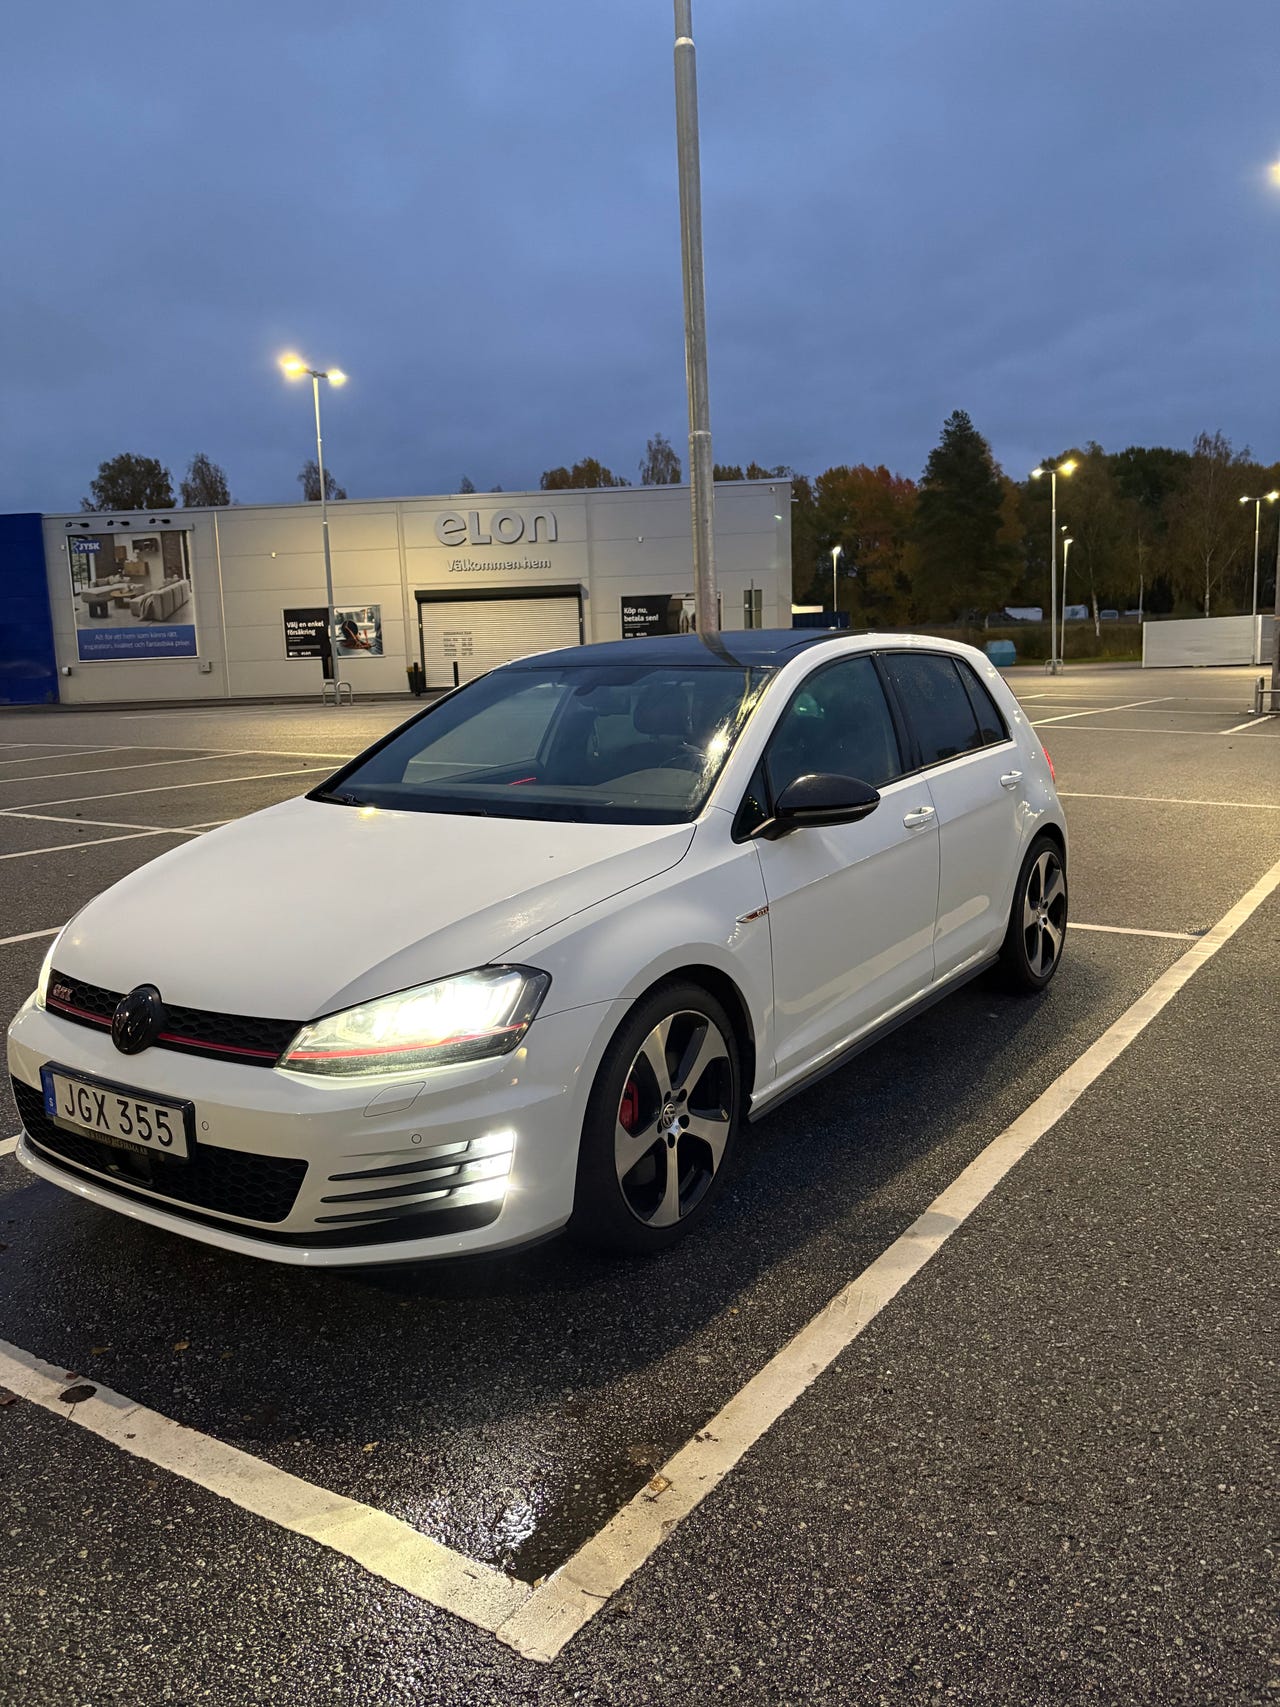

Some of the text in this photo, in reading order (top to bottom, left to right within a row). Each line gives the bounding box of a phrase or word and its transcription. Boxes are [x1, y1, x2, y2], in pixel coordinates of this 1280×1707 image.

[79, 542, 100, 551] JYSK
[447, 557, 551, 572] Välkommen hem
[624, 614, 644, 622] betala
[286, 621, 298, 629] Välj
[49, 1097, 54, 1107] S
[65, 1084, 173, 1147] JGX 355
